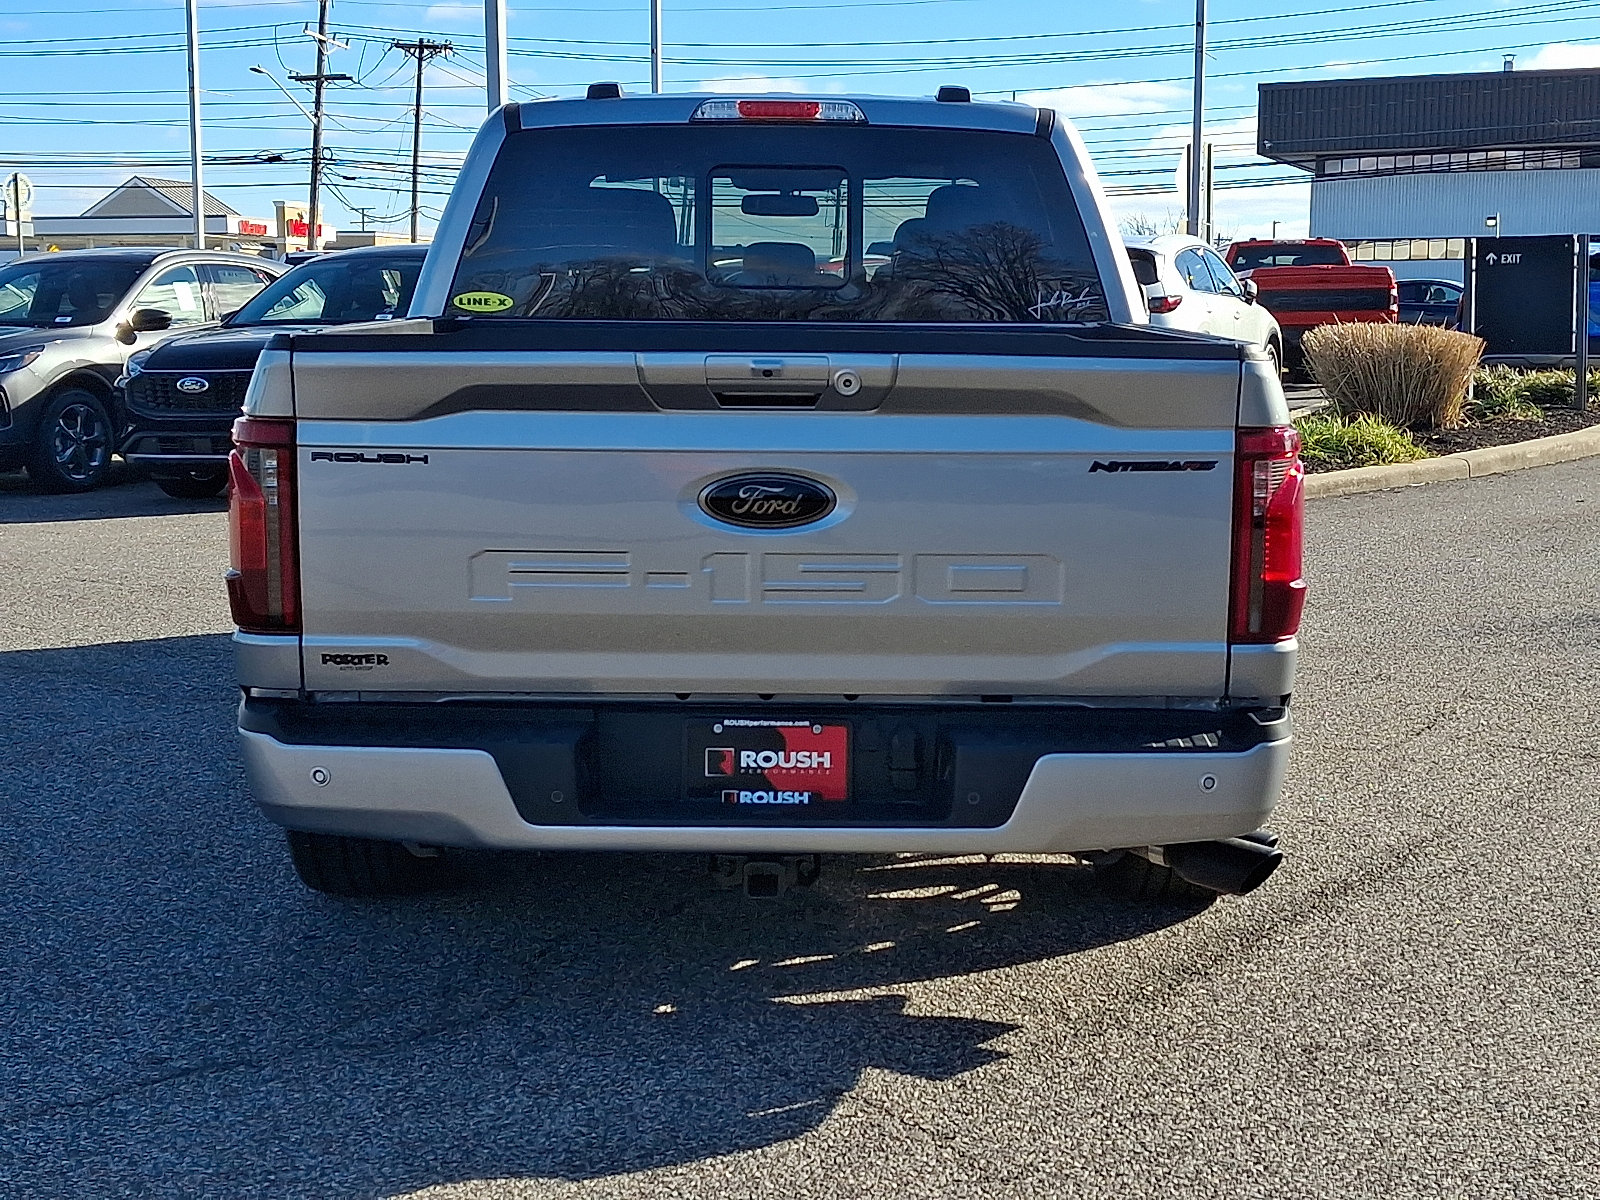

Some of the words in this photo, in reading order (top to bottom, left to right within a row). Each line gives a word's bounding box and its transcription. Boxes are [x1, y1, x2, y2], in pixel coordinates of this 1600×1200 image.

[1501, 254, 1522, 264] EXIT
[458, 297, 509, 307] LINE-X
[311, 452, 429, 465] ROUSH
[731, 485, 803, 514] Ford
[467, 549, 1064, 606] F-150
[321, 653, 390, 665] PORTER
[740, 750, 831, 768] ROUSH
[739, 791, 809, 804] ROUSH
